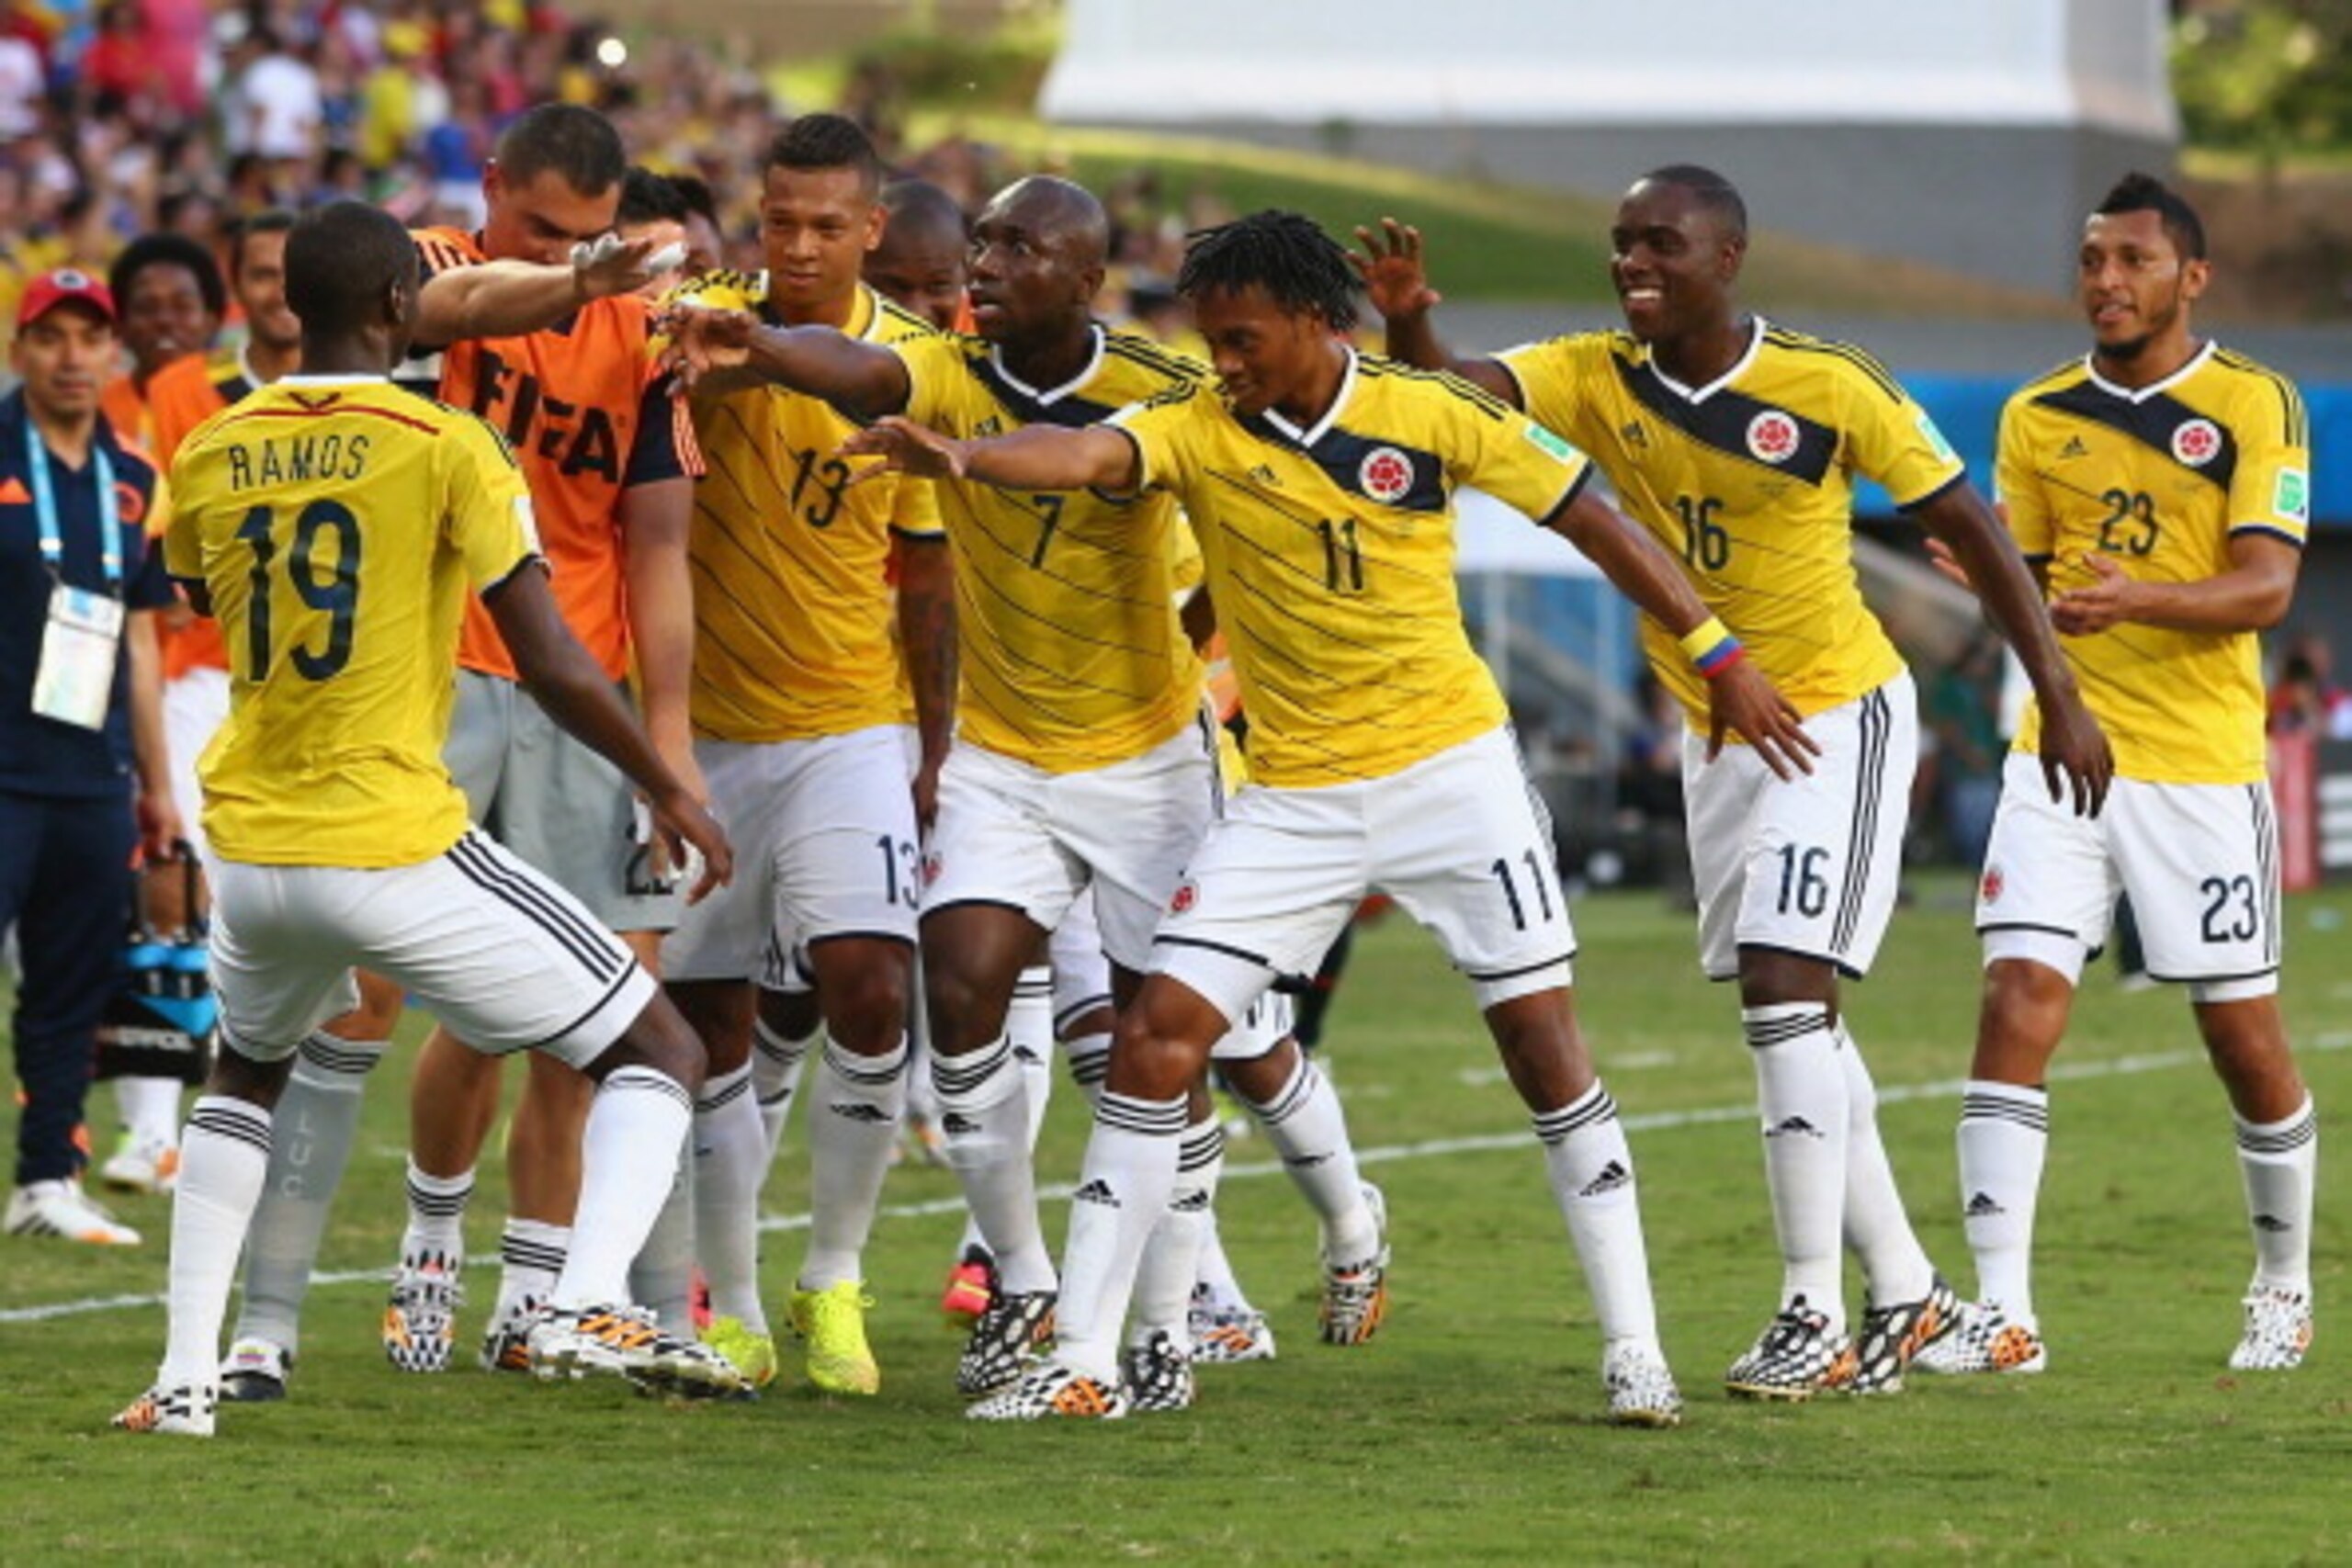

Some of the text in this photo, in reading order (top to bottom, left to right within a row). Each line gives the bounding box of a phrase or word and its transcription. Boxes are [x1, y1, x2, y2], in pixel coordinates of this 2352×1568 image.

[471, 346, 619, 483] FIFA
[229, 434, 369, 492] RAMOS
[791, 446, 851, 529] 13
[1030, 494, 1064, 570] 7
[1317, 517, 1363, 591] 11
[1676, 494, 1728, 570] 16
[2098, 488, 2158, 555] 23
[233, 498, 362, 682] 19
[1489, 846, 1552, 931] 11
[1776, 842, 1829, 919] 16
[2199, 874, 2257, 943] 23
